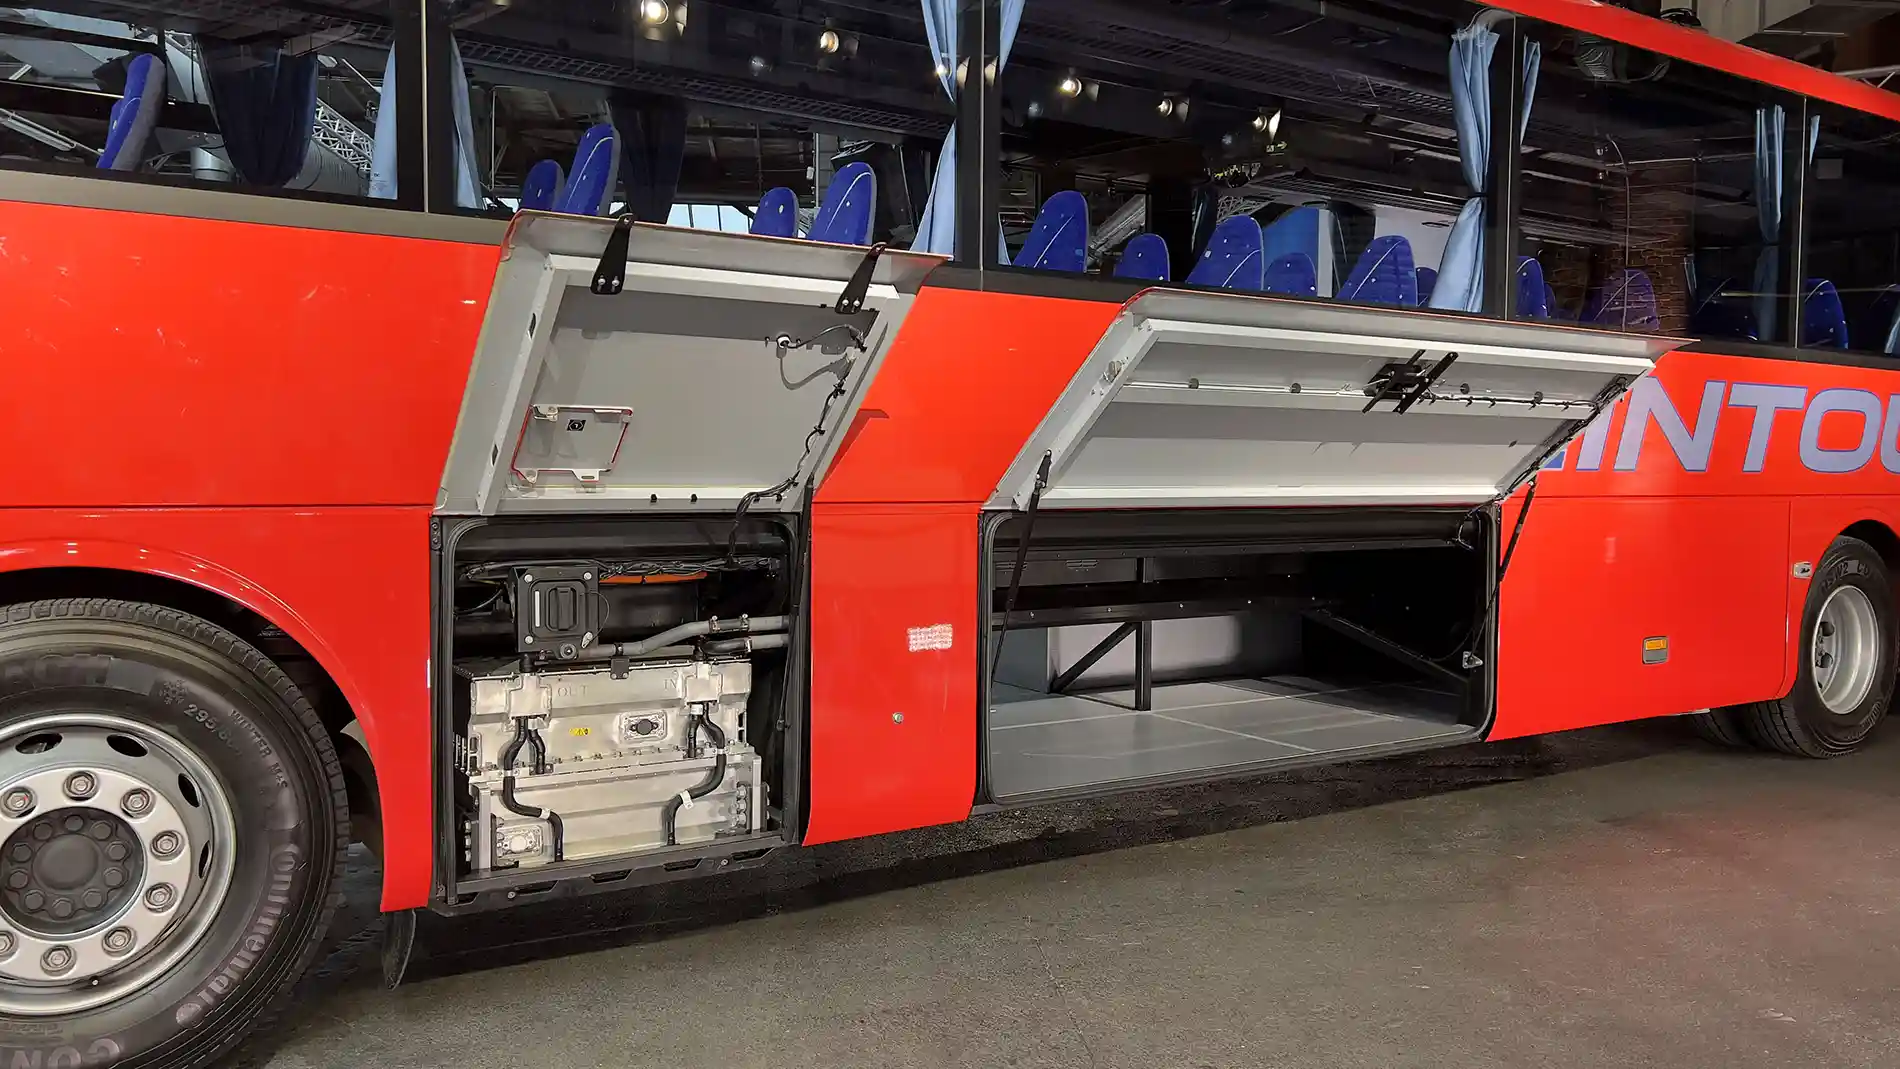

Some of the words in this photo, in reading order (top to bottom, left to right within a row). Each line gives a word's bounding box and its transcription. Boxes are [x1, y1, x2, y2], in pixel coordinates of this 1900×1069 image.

[557, 684, 588, 697] OUT
[663, 678, 678, 690] IN
[228, 708, 272, 758] WINTER
[196, 843, 301, 1006] Continental
